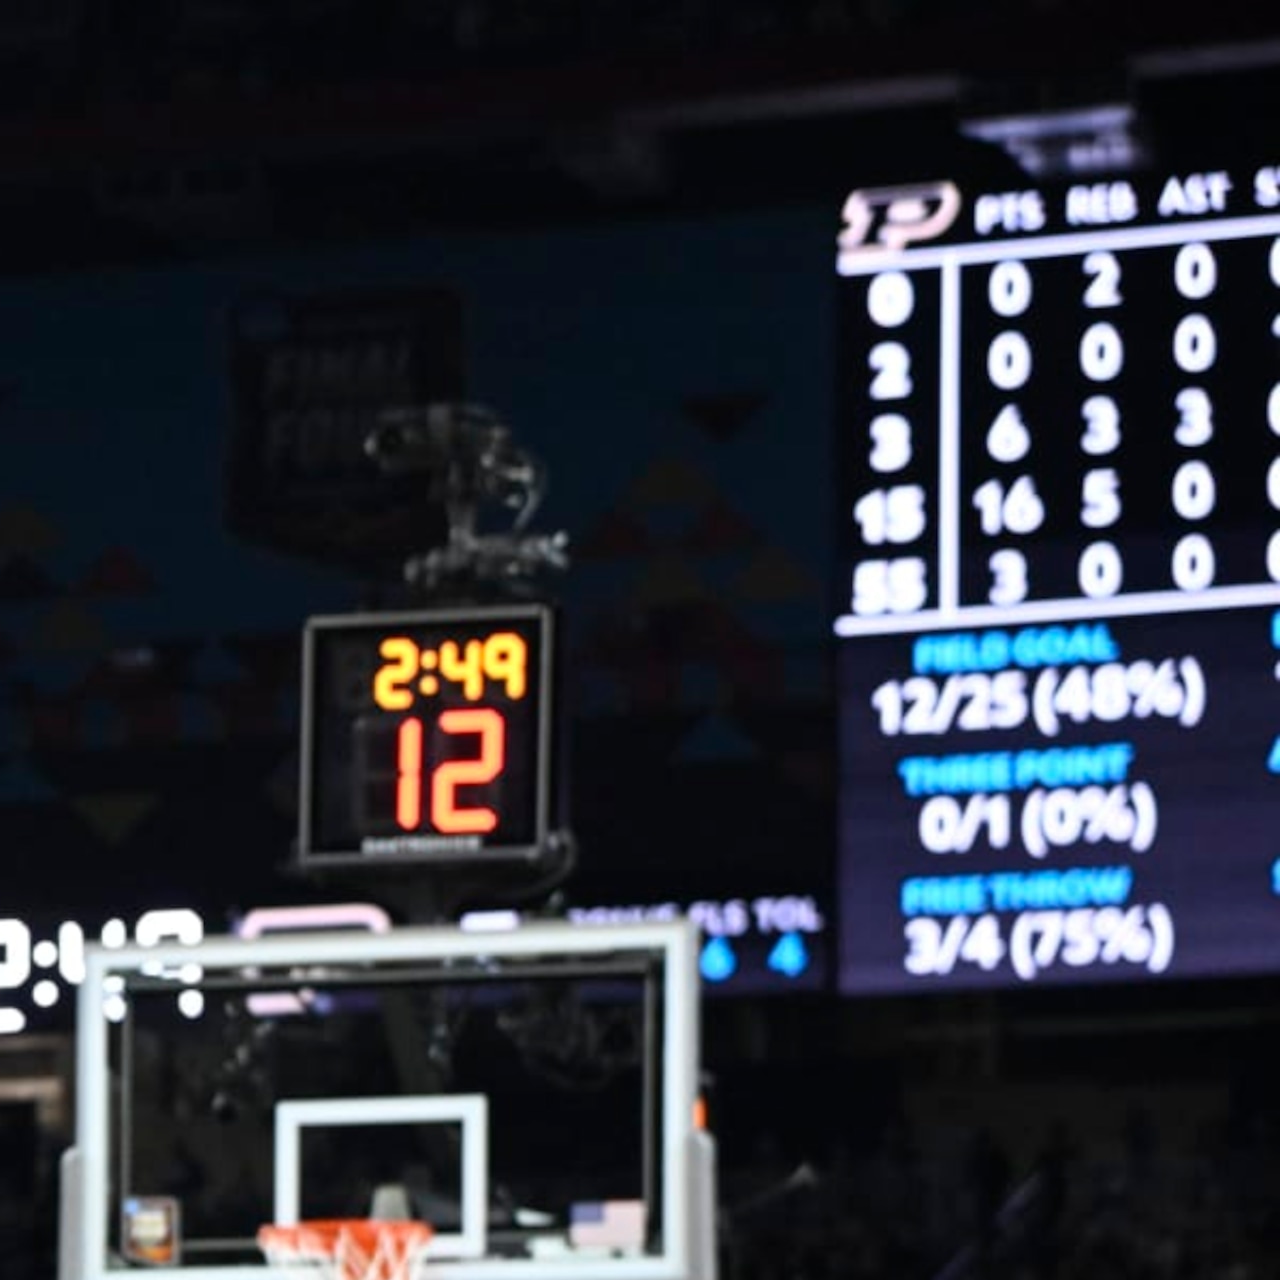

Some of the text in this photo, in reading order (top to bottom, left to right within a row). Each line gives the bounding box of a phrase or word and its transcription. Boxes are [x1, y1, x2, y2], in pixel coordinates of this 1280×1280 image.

[974, 191, 1046, 235] PTS
[1158, 171, 1233, 215] AST
[867, 242, 1216, 328] 0 0 2 0
[869, 314, 1216, 400] 2 0 0 0
[869, 387, 1213, 472] 3 6 3 3
[854, 460, 1215, 545] 15 16 5 0
[989, 549, 1027, 606] 3
[1079, 541, 1122, 598] 0
[1172, 533, 1215, 592] 0
[374, 632, 527, 711] 2:49
[1012, 622, 1120, 668] GOAL
[872, 670, 1028, 735] 12/25
[397, 708, 505, 833] 12
[1015, 742, 1134, 788] POINT
[918, 782, 1157, 858] 0/1 (0%)
[767, 930, 810, 977] 4
[903, 902, 1174, 980] 3/4 (75%)
